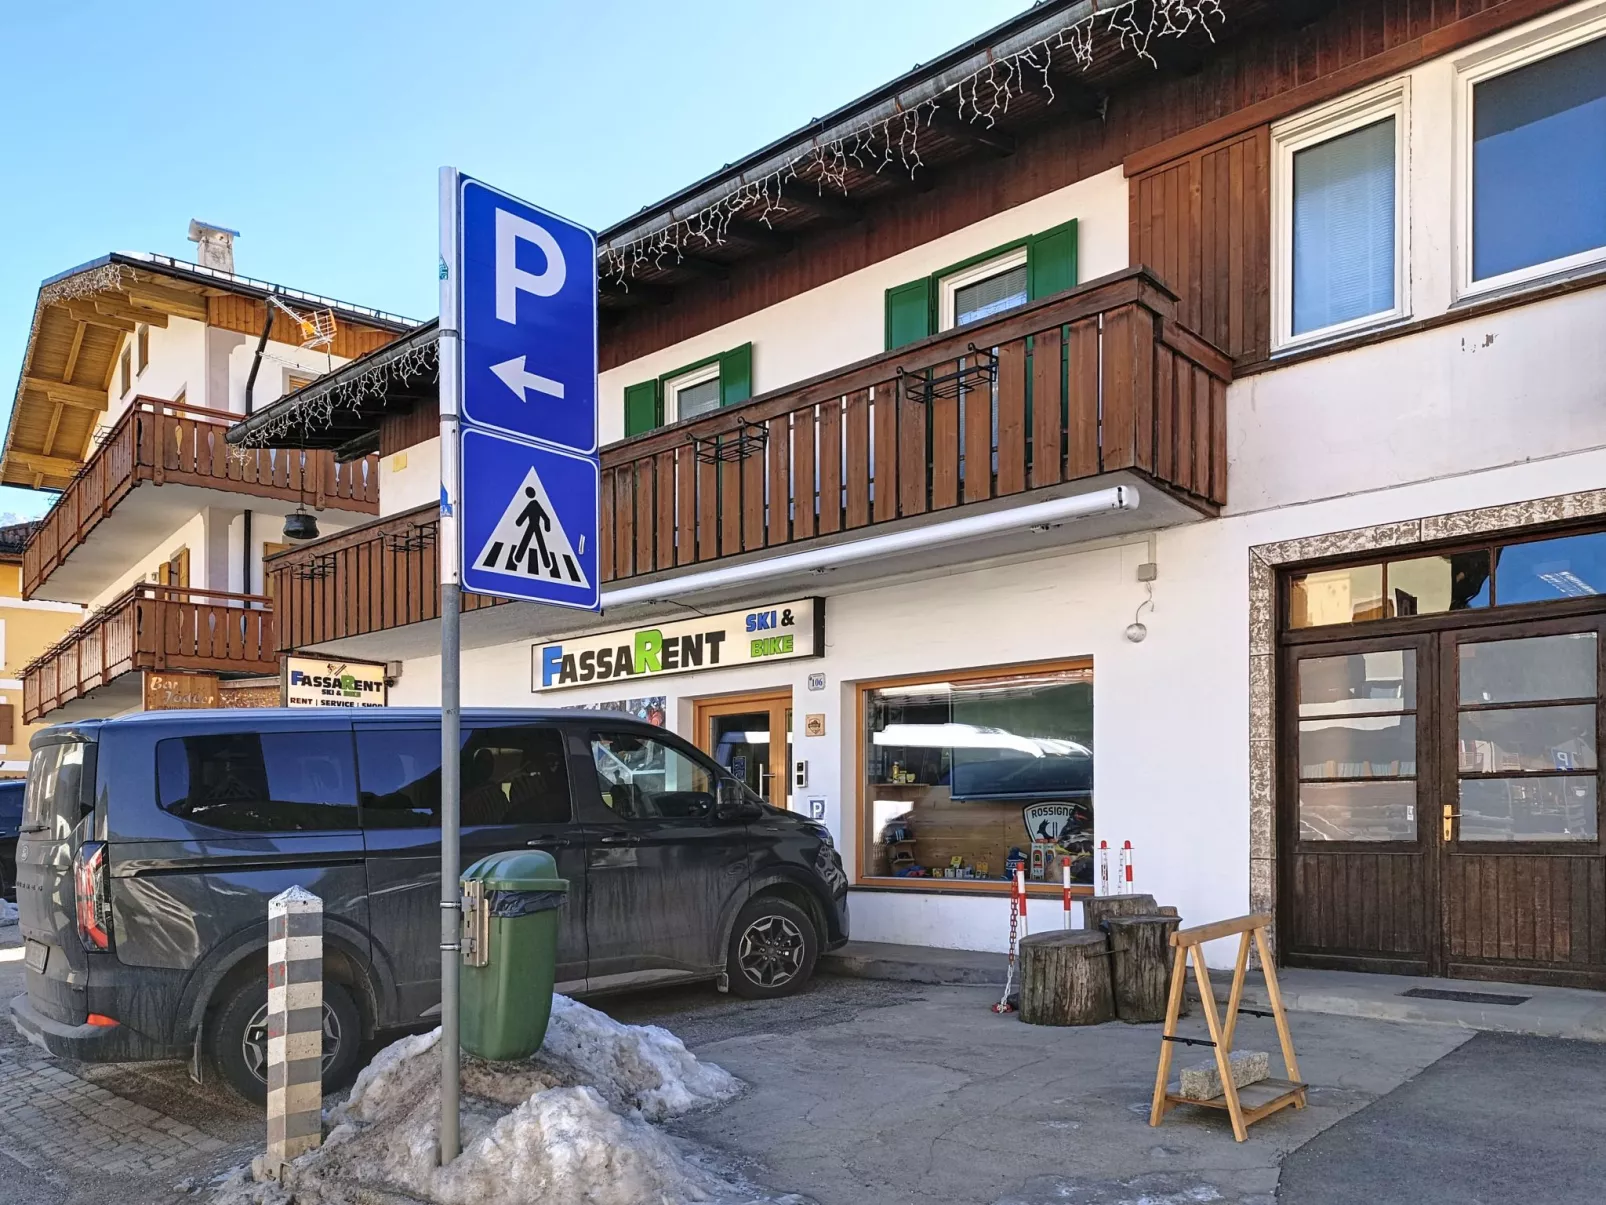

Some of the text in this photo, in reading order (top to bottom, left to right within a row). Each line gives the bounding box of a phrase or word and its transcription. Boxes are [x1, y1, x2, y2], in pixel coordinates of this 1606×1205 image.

[495, 207, 567, 325] P
[745, 608, 795, 632] SKI &
[750, 634, 794, 658] BIKE
[150, 676, 179, 691] Bar
[811, 677, 823, 687] 106
[290, 697, 313, 705] RENT
[320, 699, 355, 707] SERVICE
[813, 802, 823, 819] P
[1031, 806, 1074, 819] ROSSIGNO
